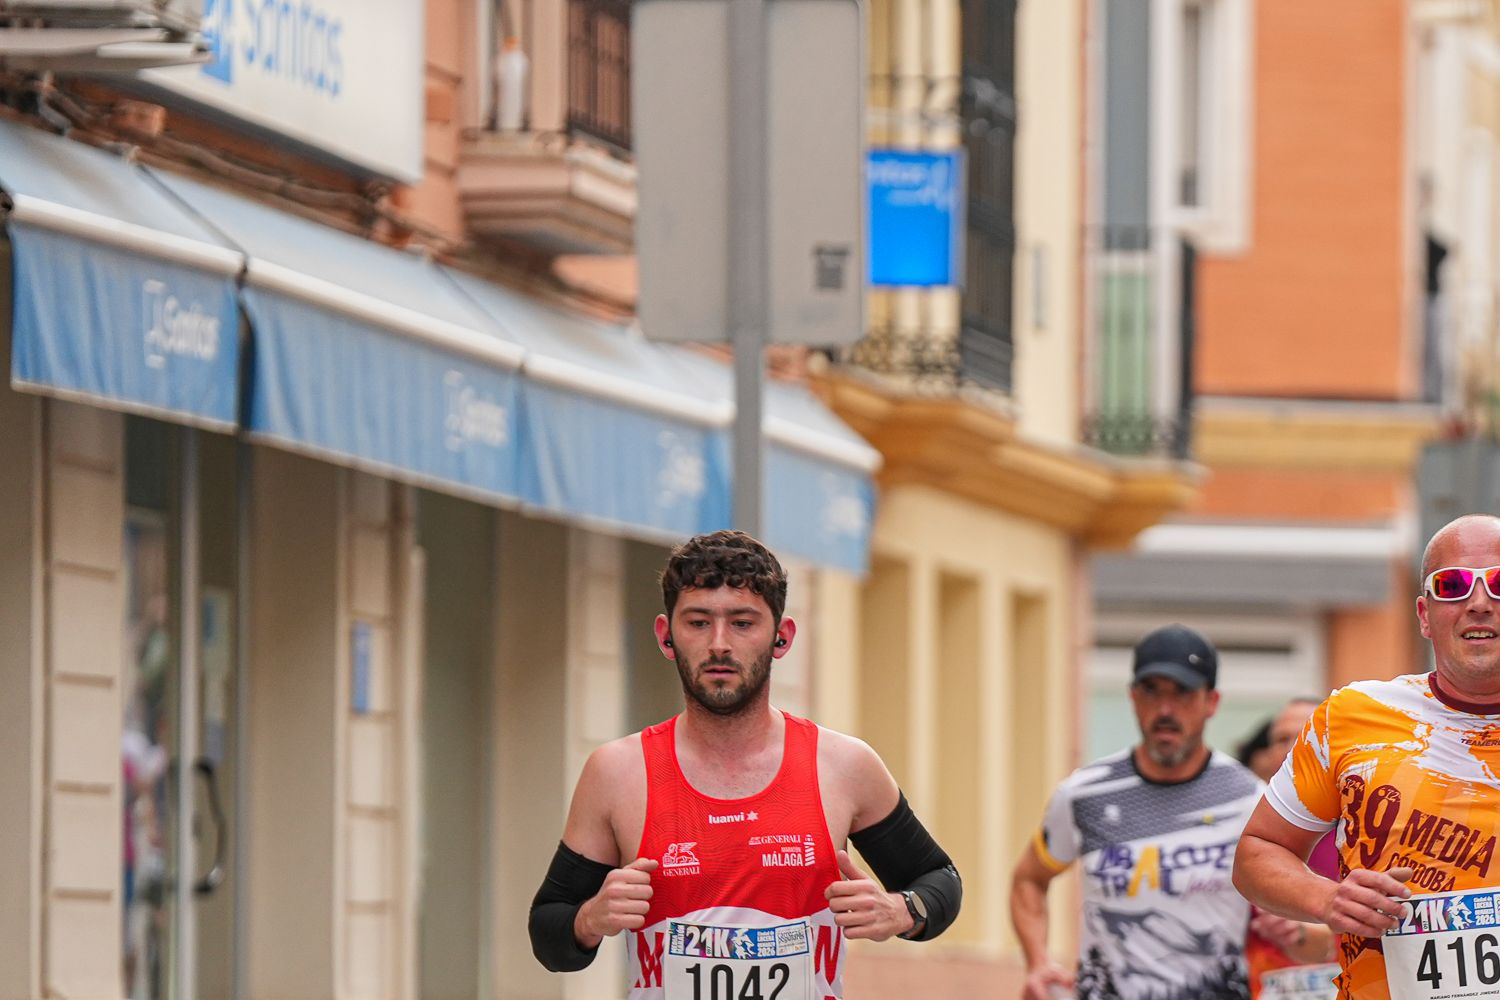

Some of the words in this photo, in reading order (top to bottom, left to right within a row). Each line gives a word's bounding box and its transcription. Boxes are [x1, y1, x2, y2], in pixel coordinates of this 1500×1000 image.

[708, 811, 745, 824] luanvi
[1340, 774, 1402, 869] 39
[1399, 808, 1497, 878] MEDIA
[760, 834, 801, 845] GENERALI
[762, 850, 803, 867] MÁLAGA
[662, 866, 700, 877] GENERALI
[1401, 899, 1449, 935] 21K
[1475, 914, 1495, 926] 2026
[685, 925, 731, 958] 21K
